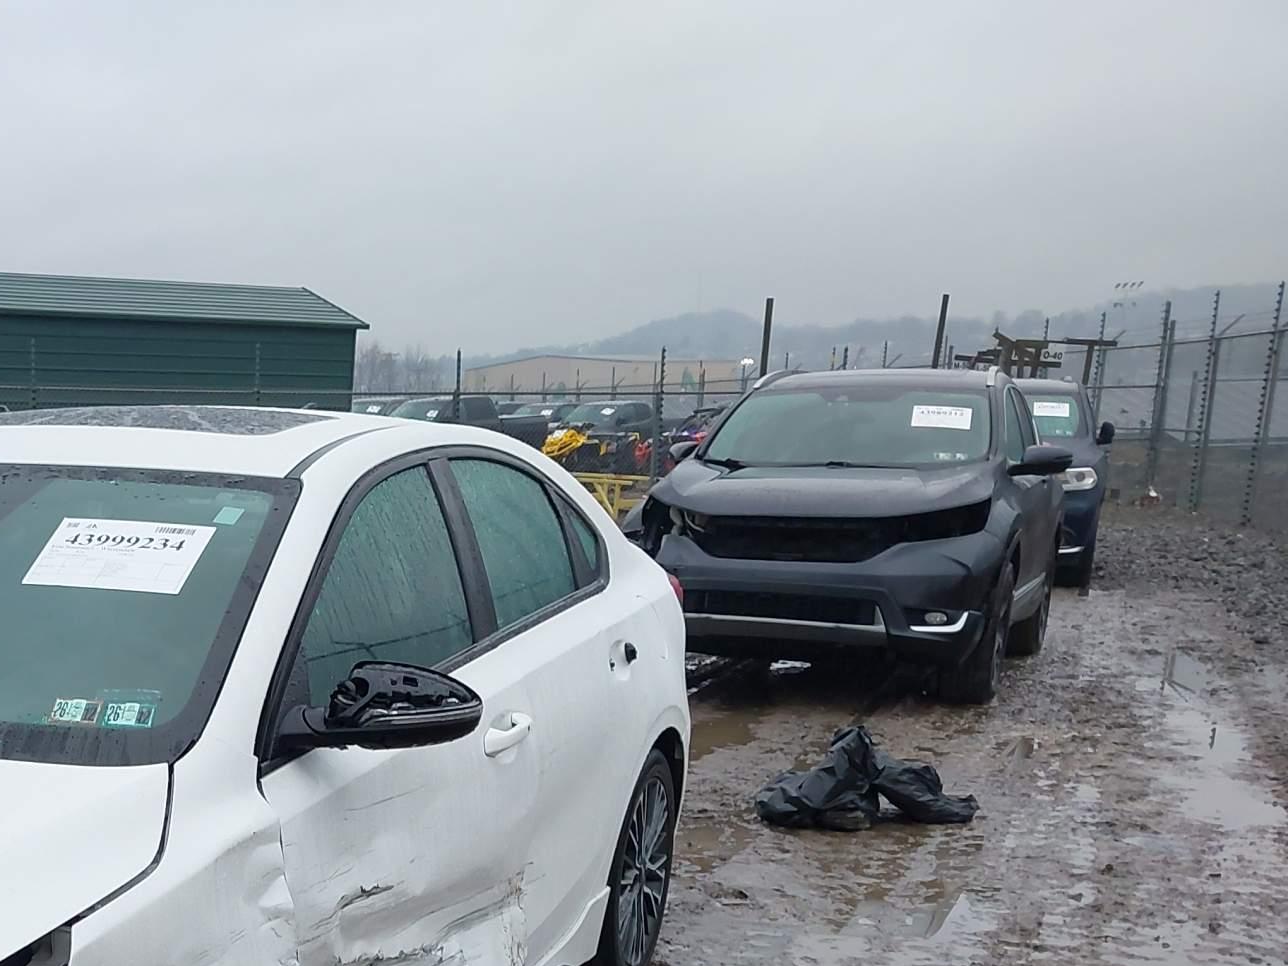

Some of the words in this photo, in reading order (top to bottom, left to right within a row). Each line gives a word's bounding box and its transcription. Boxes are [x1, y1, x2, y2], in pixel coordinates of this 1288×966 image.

[65, 532, 186, 552] 43999234
[53, 701, 69, 718] 26
[107, 705, 121, 722] 26
